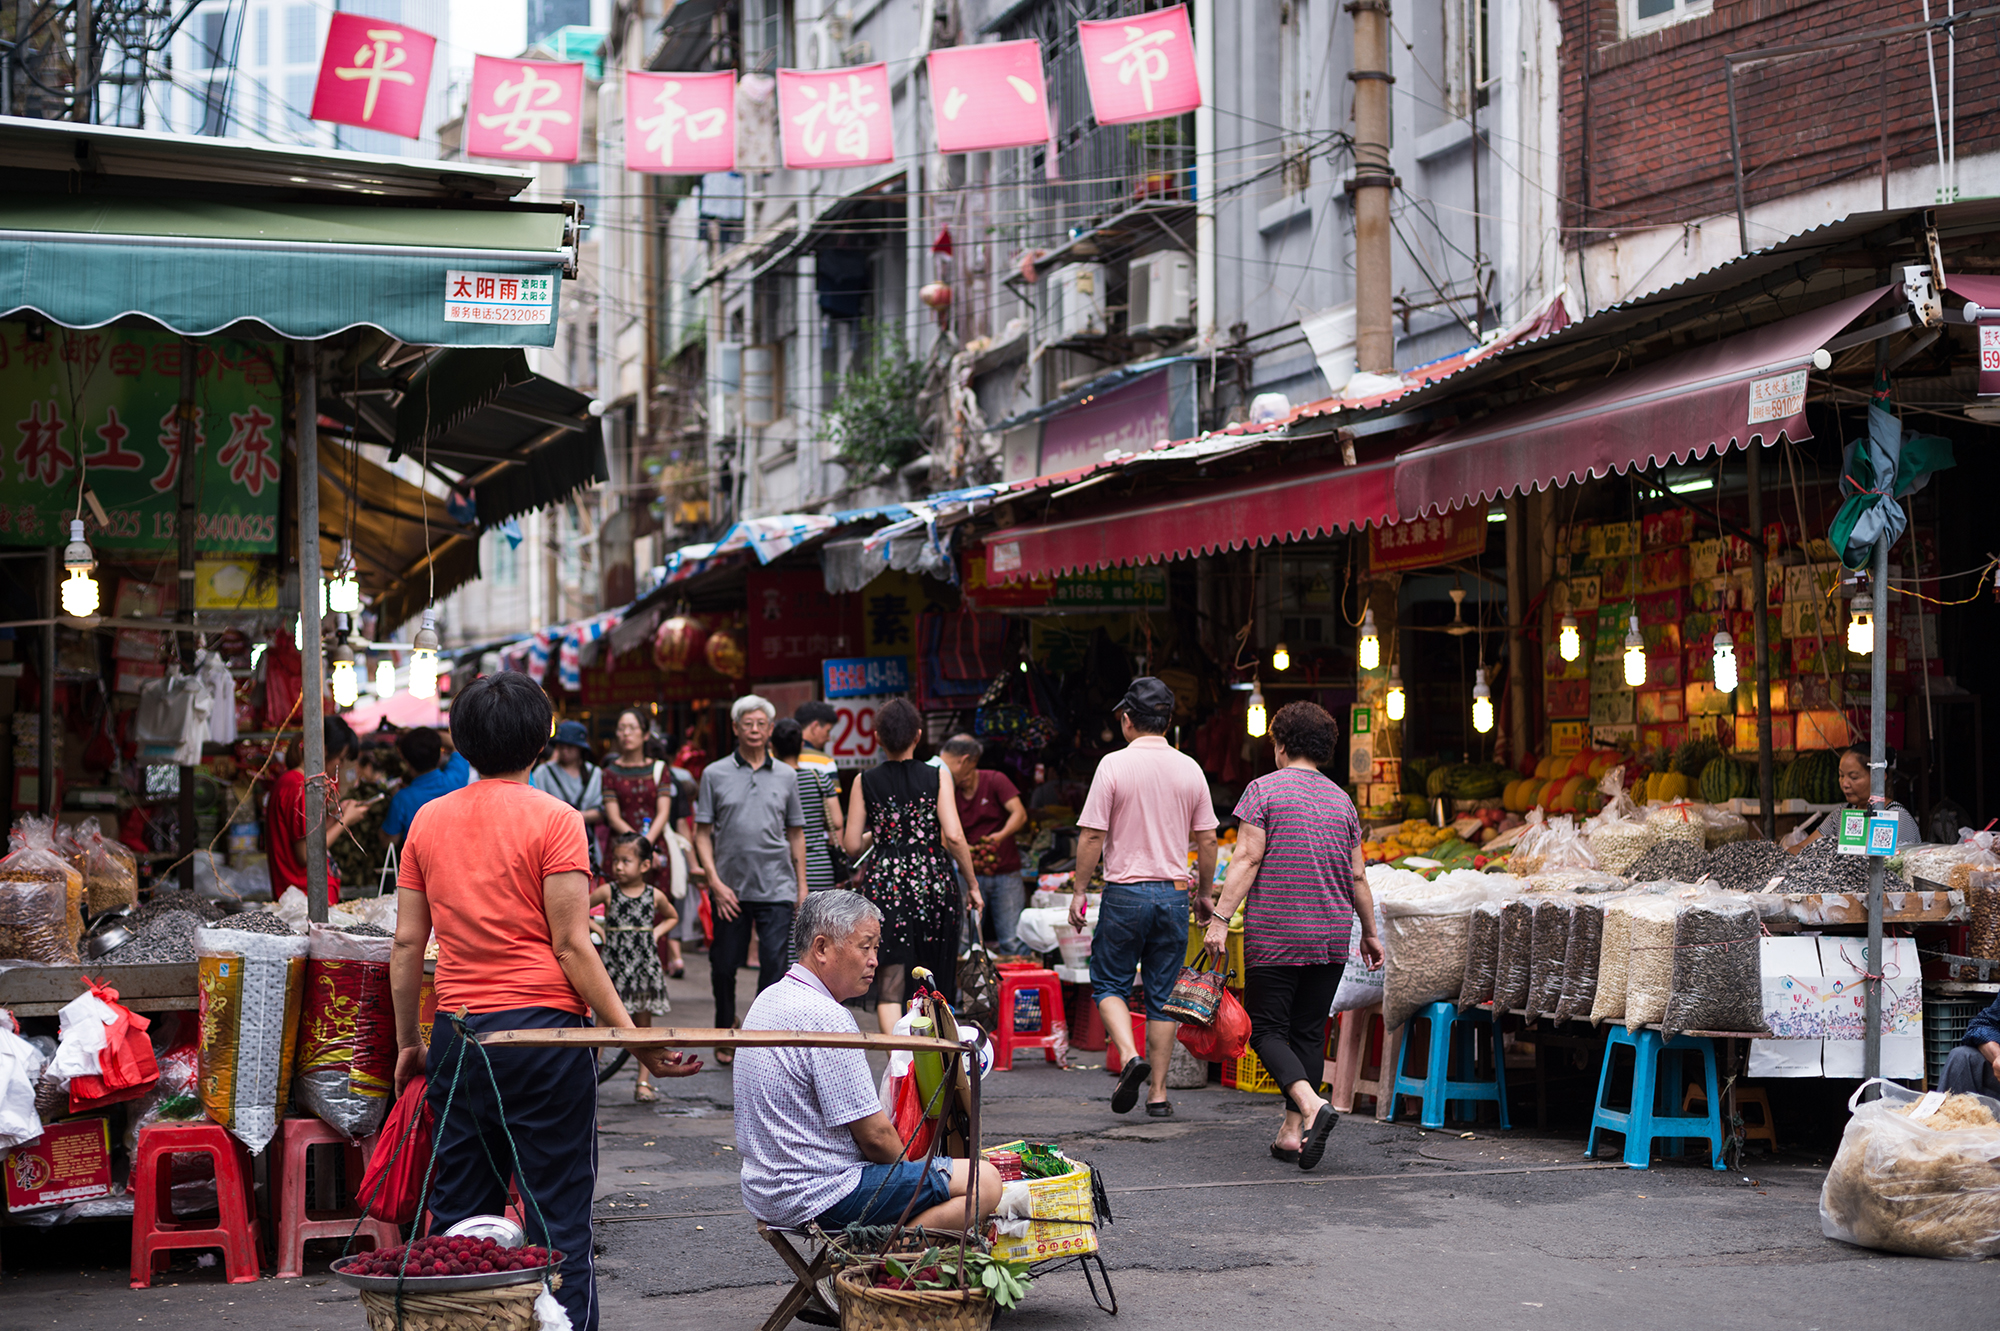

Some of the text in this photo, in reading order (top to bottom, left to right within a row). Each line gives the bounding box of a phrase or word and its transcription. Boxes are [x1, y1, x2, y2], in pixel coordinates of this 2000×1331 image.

[453, 275, 519, 301] 太阳雨
[520, 291, 547, 302] 太阳伞
[0, 331, 275, 386] 帮邮空运外省
[0, 400, 280, 497] 林土笋冻
[152, 510, 277, 543] 138400625
[833, 707, 877, 756] 29
